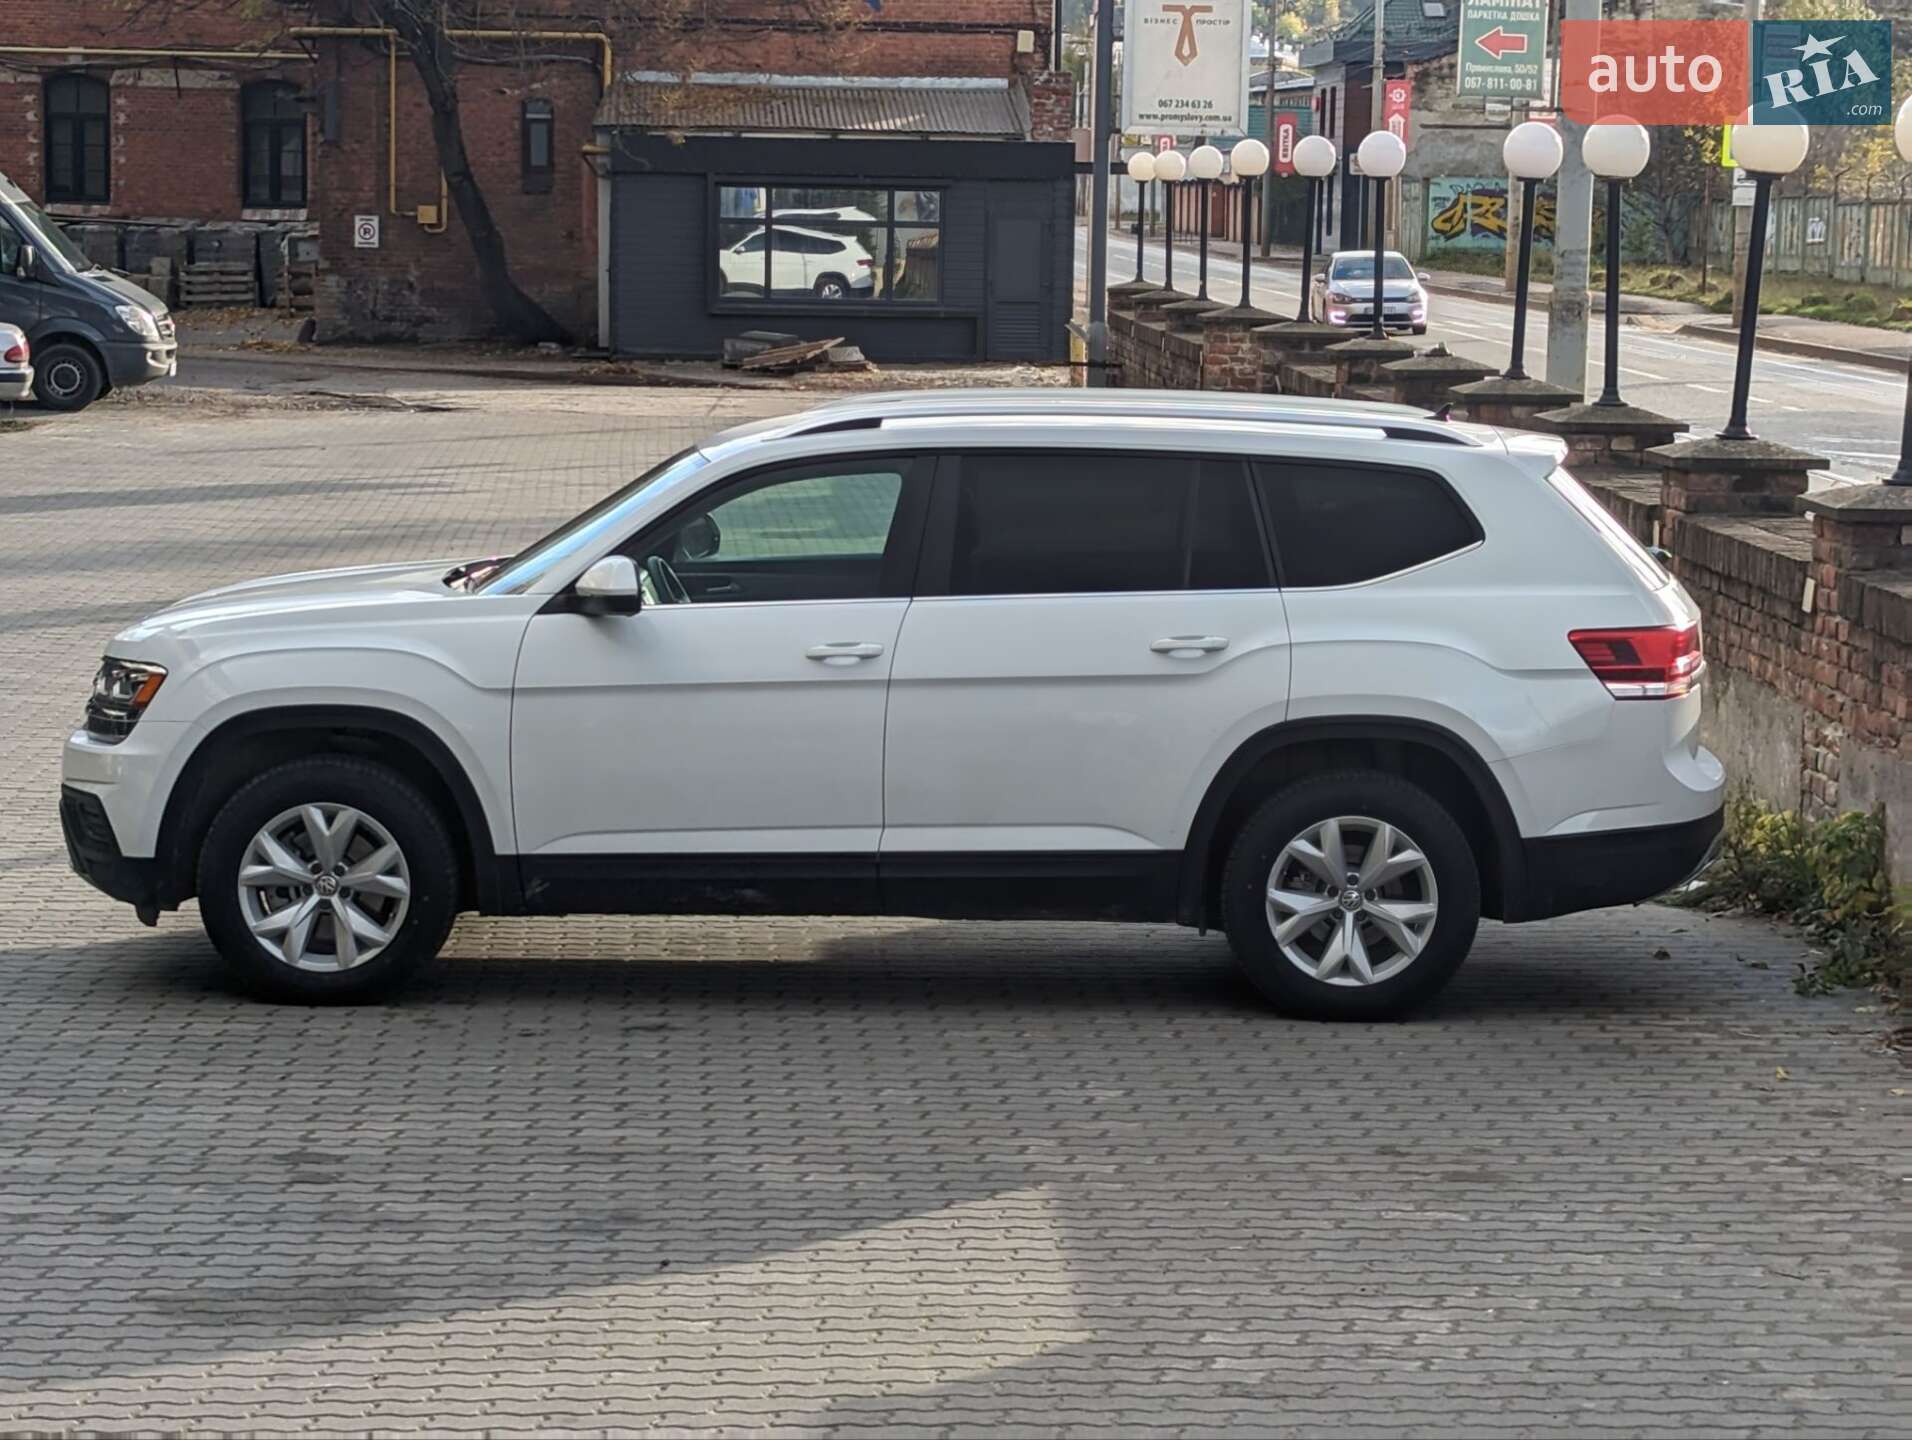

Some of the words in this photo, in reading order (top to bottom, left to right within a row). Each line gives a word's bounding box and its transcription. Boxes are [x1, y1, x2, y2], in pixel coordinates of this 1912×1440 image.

[1158, 99, 1173, 108] 067
[1175, 99, 1189, 109] 234
[1191, 100, 1201, 109] 63
[1203, 100, 1213, 109] 26
[1138, 112, 1232, 122] www.promyslovy.com.ua
